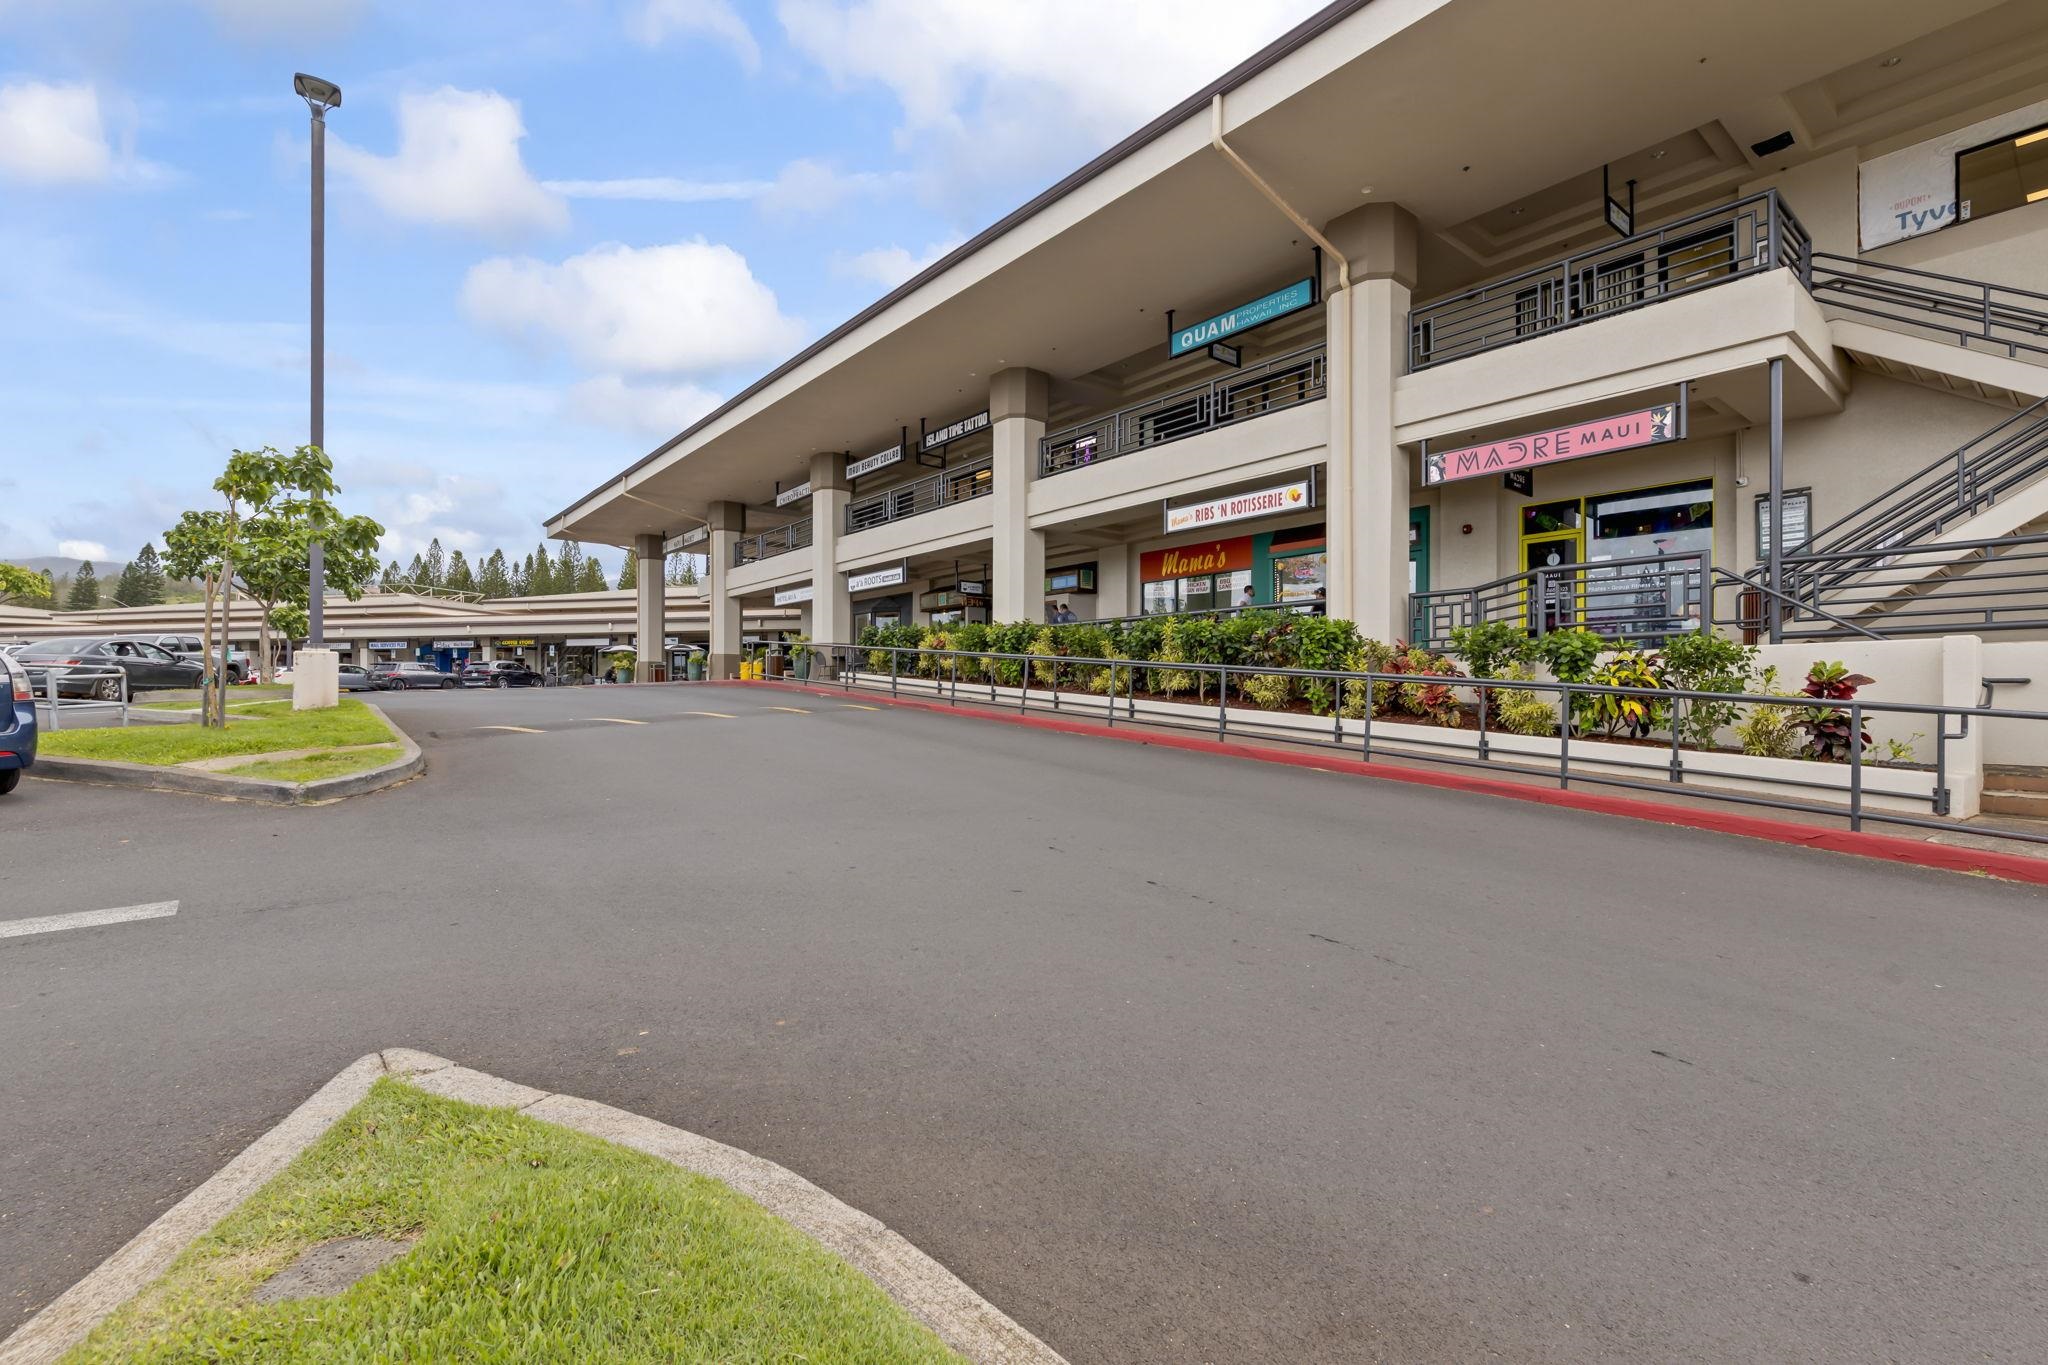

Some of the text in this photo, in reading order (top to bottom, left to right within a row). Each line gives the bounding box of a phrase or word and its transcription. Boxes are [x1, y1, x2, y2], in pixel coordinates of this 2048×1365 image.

[1236, 290, 1298, 319] PROPERTIES
[1181, 314, 1237, 347] QUAM
[926, 411, 988, 447] ISLAND TIME TATTOO
[861, 458, 879, 472] BEAUTY
[880, 448, 899, 464] COLLAB
[1456, 422, 1640, 475] MADRE MAUI
[1195, 505, 1214, 522] RIBS
[1230, 492, 1283, 516] ROTISSERIE
[1161, 543, 1226, 577] Mama's
[864, 574, 883, 587] ROOTS
